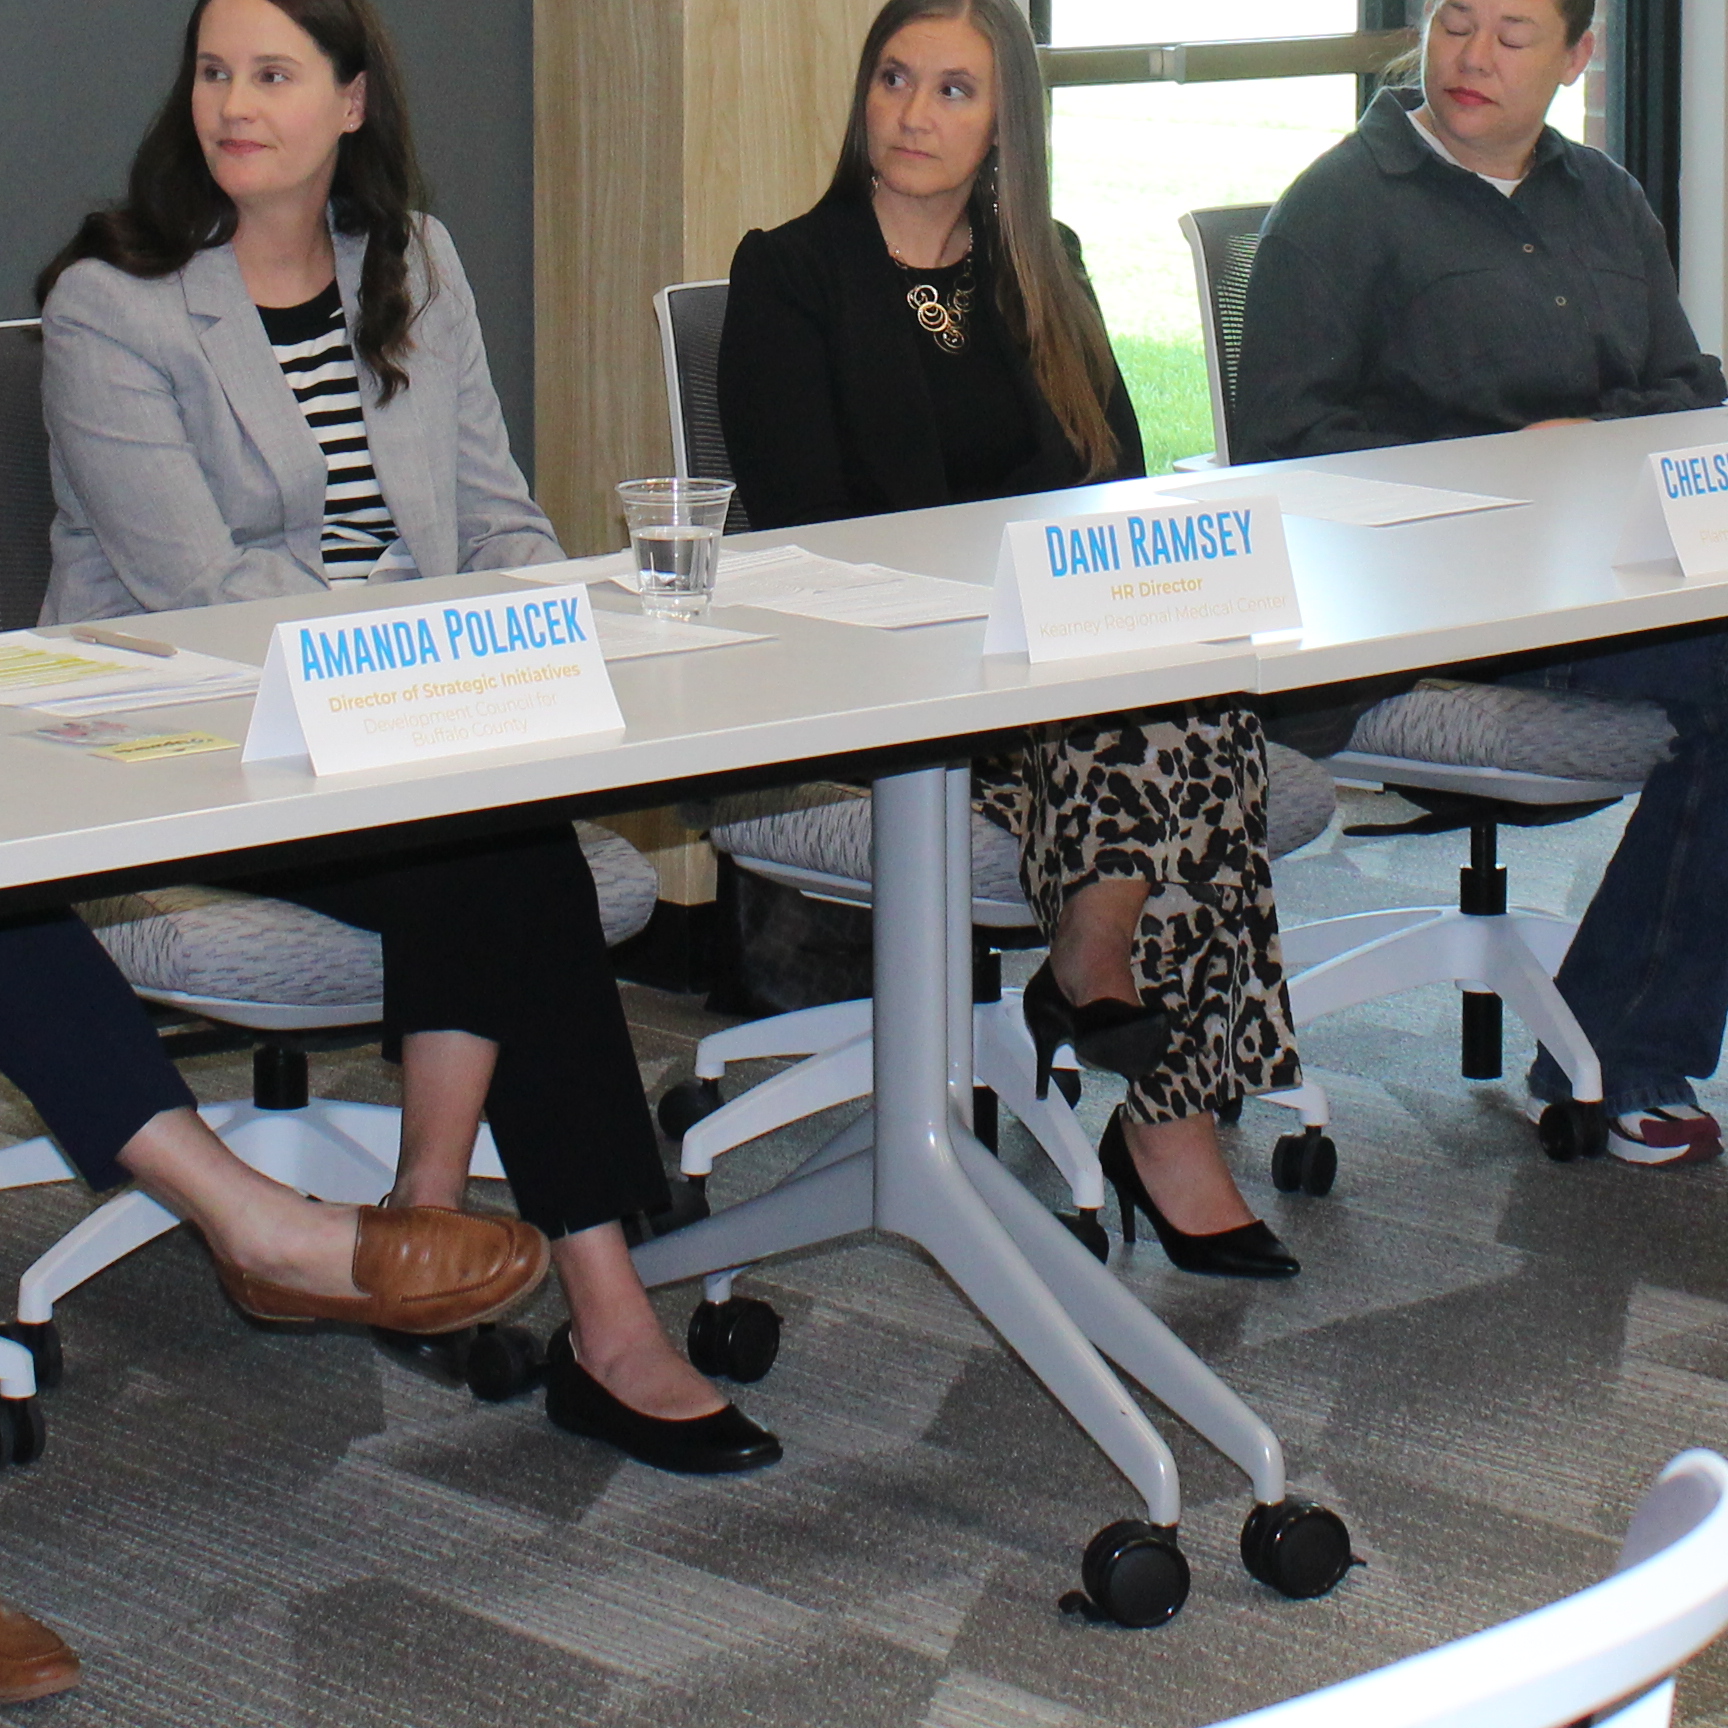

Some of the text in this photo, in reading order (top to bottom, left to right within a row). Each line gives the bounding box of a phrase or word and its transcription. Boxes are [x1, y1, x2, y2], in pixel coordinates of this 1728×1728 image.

[1044, 508, 1253, 578] DANI RAMSEY
[1110, 577, 1204, 601] HR Director
[1039, 595, 1287, 639] Kearney Regional Medical Center
[300, 597, 587, 682] AMANDA POLACEK
[328, 662, 581, 713] Director of Strategic Initiatives
[364, 692, 558, 735] Development Council for
[412, 717, 528, 747] Buffalo County
